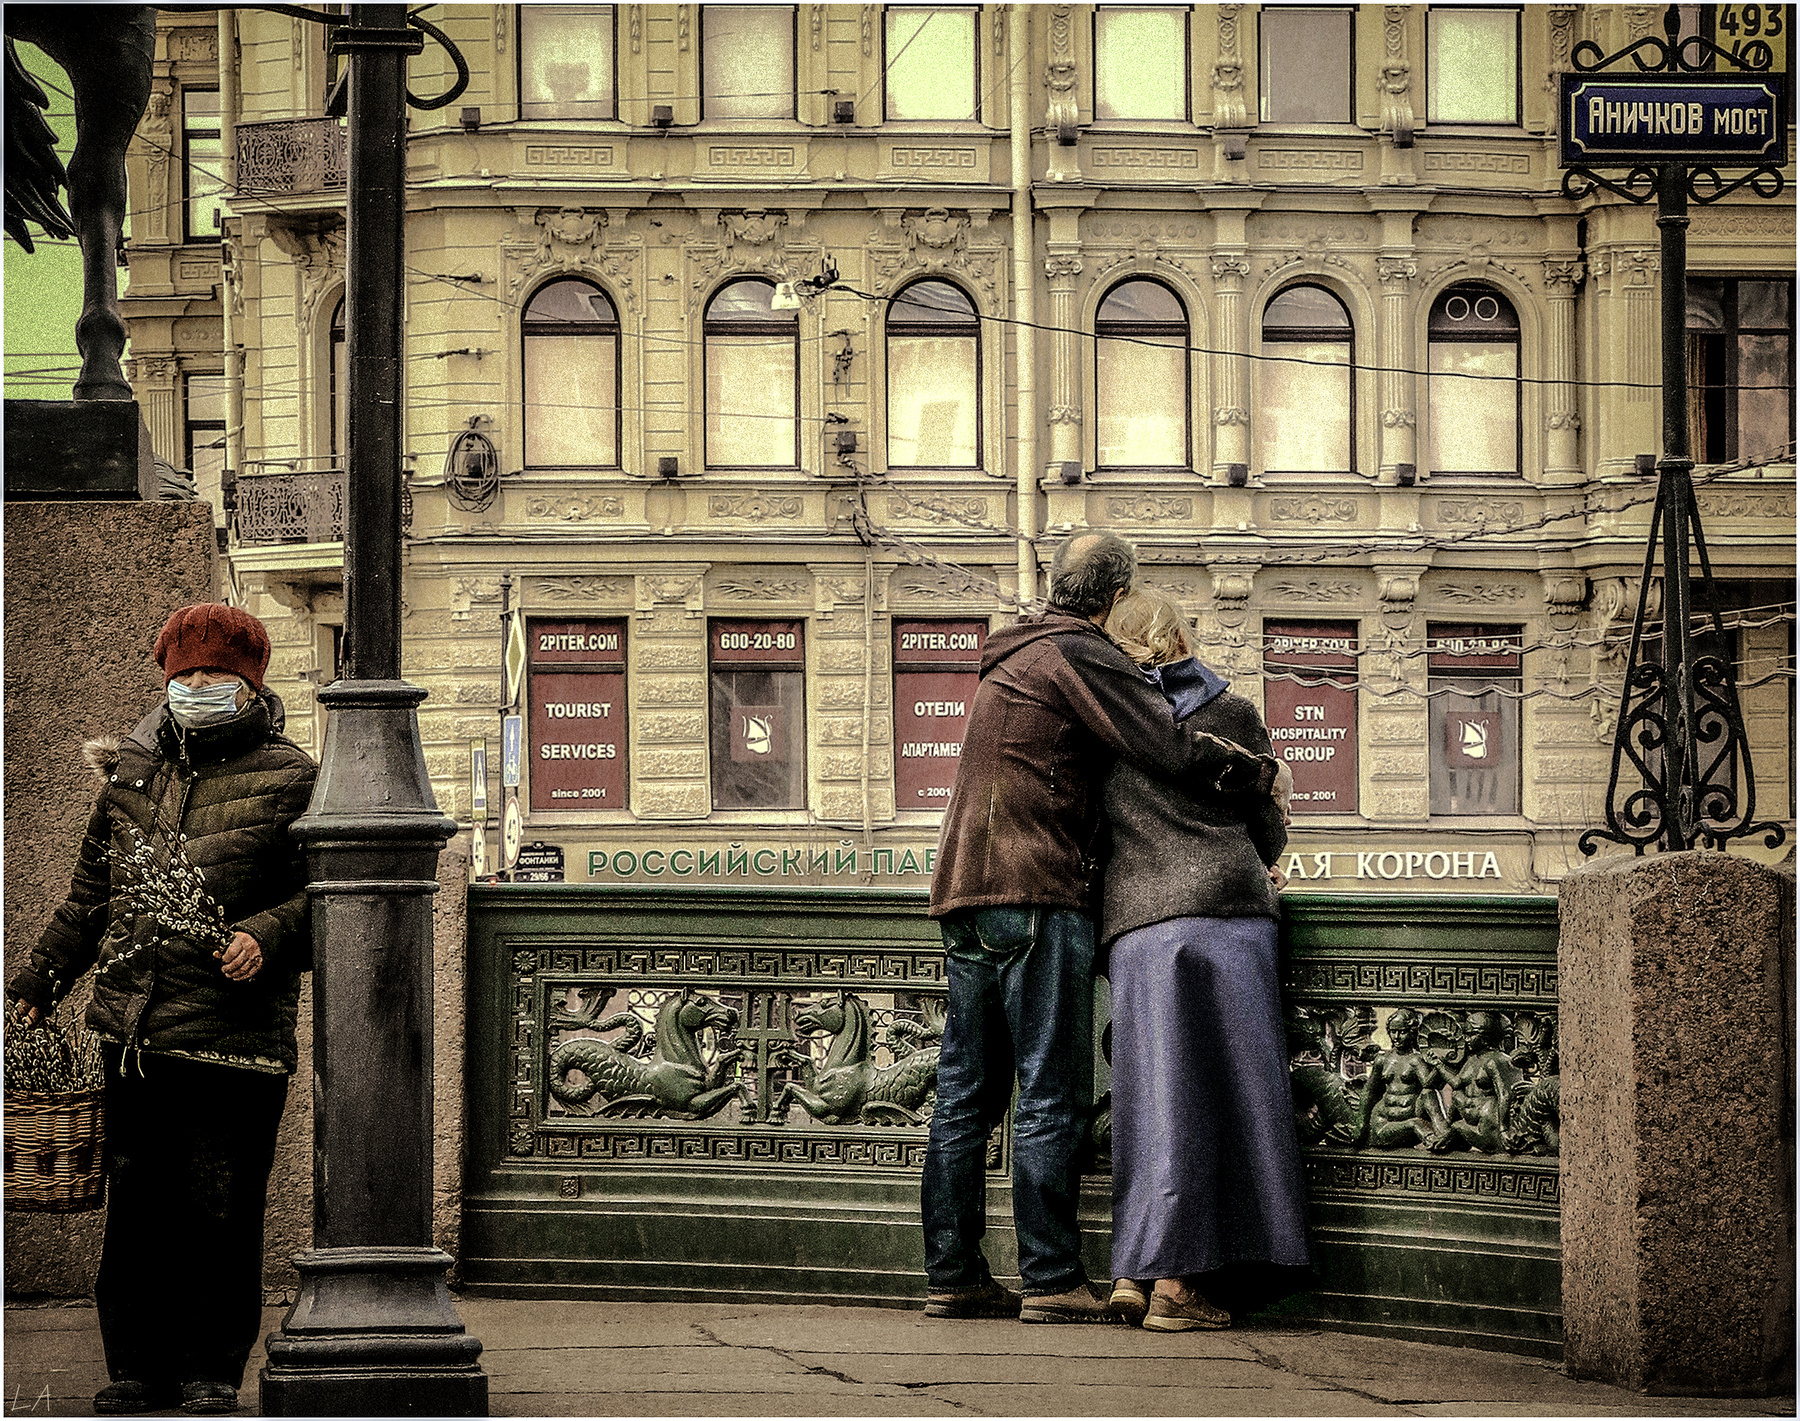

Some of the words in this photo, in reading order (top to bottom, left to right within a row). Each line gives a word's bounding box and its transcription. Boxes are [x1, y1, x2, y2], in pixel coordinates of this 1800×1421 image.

[1720, 3, 1783, 37] 493
[539, 634, 618, 651] 2PITER.COM
[720, 633, 796, 650] 600-20-80
[901, 633, 978, 650] 2PITER.COM
[545, 703, 612, 718] TOURIST
[914, 701, 965, 717] ОТЕЛИ
[1294, 705, 1325, 721] STN
[1271, 727, 1347, 741] HOSPITALITY
[540, 744, 616, 759] SERVICES
[1283, 746, 1336, 762] GROUP
[551, 788, 579, 799] since
[582, 787, 607, 799] 2001
[927, 787, 951, 797] 2001
[1312, 790, 1337, 801] 2001
[587, 842, 857, 877] РОССИЙСКИЙ
[1357, 851, 1502, 879] КОРОНА
